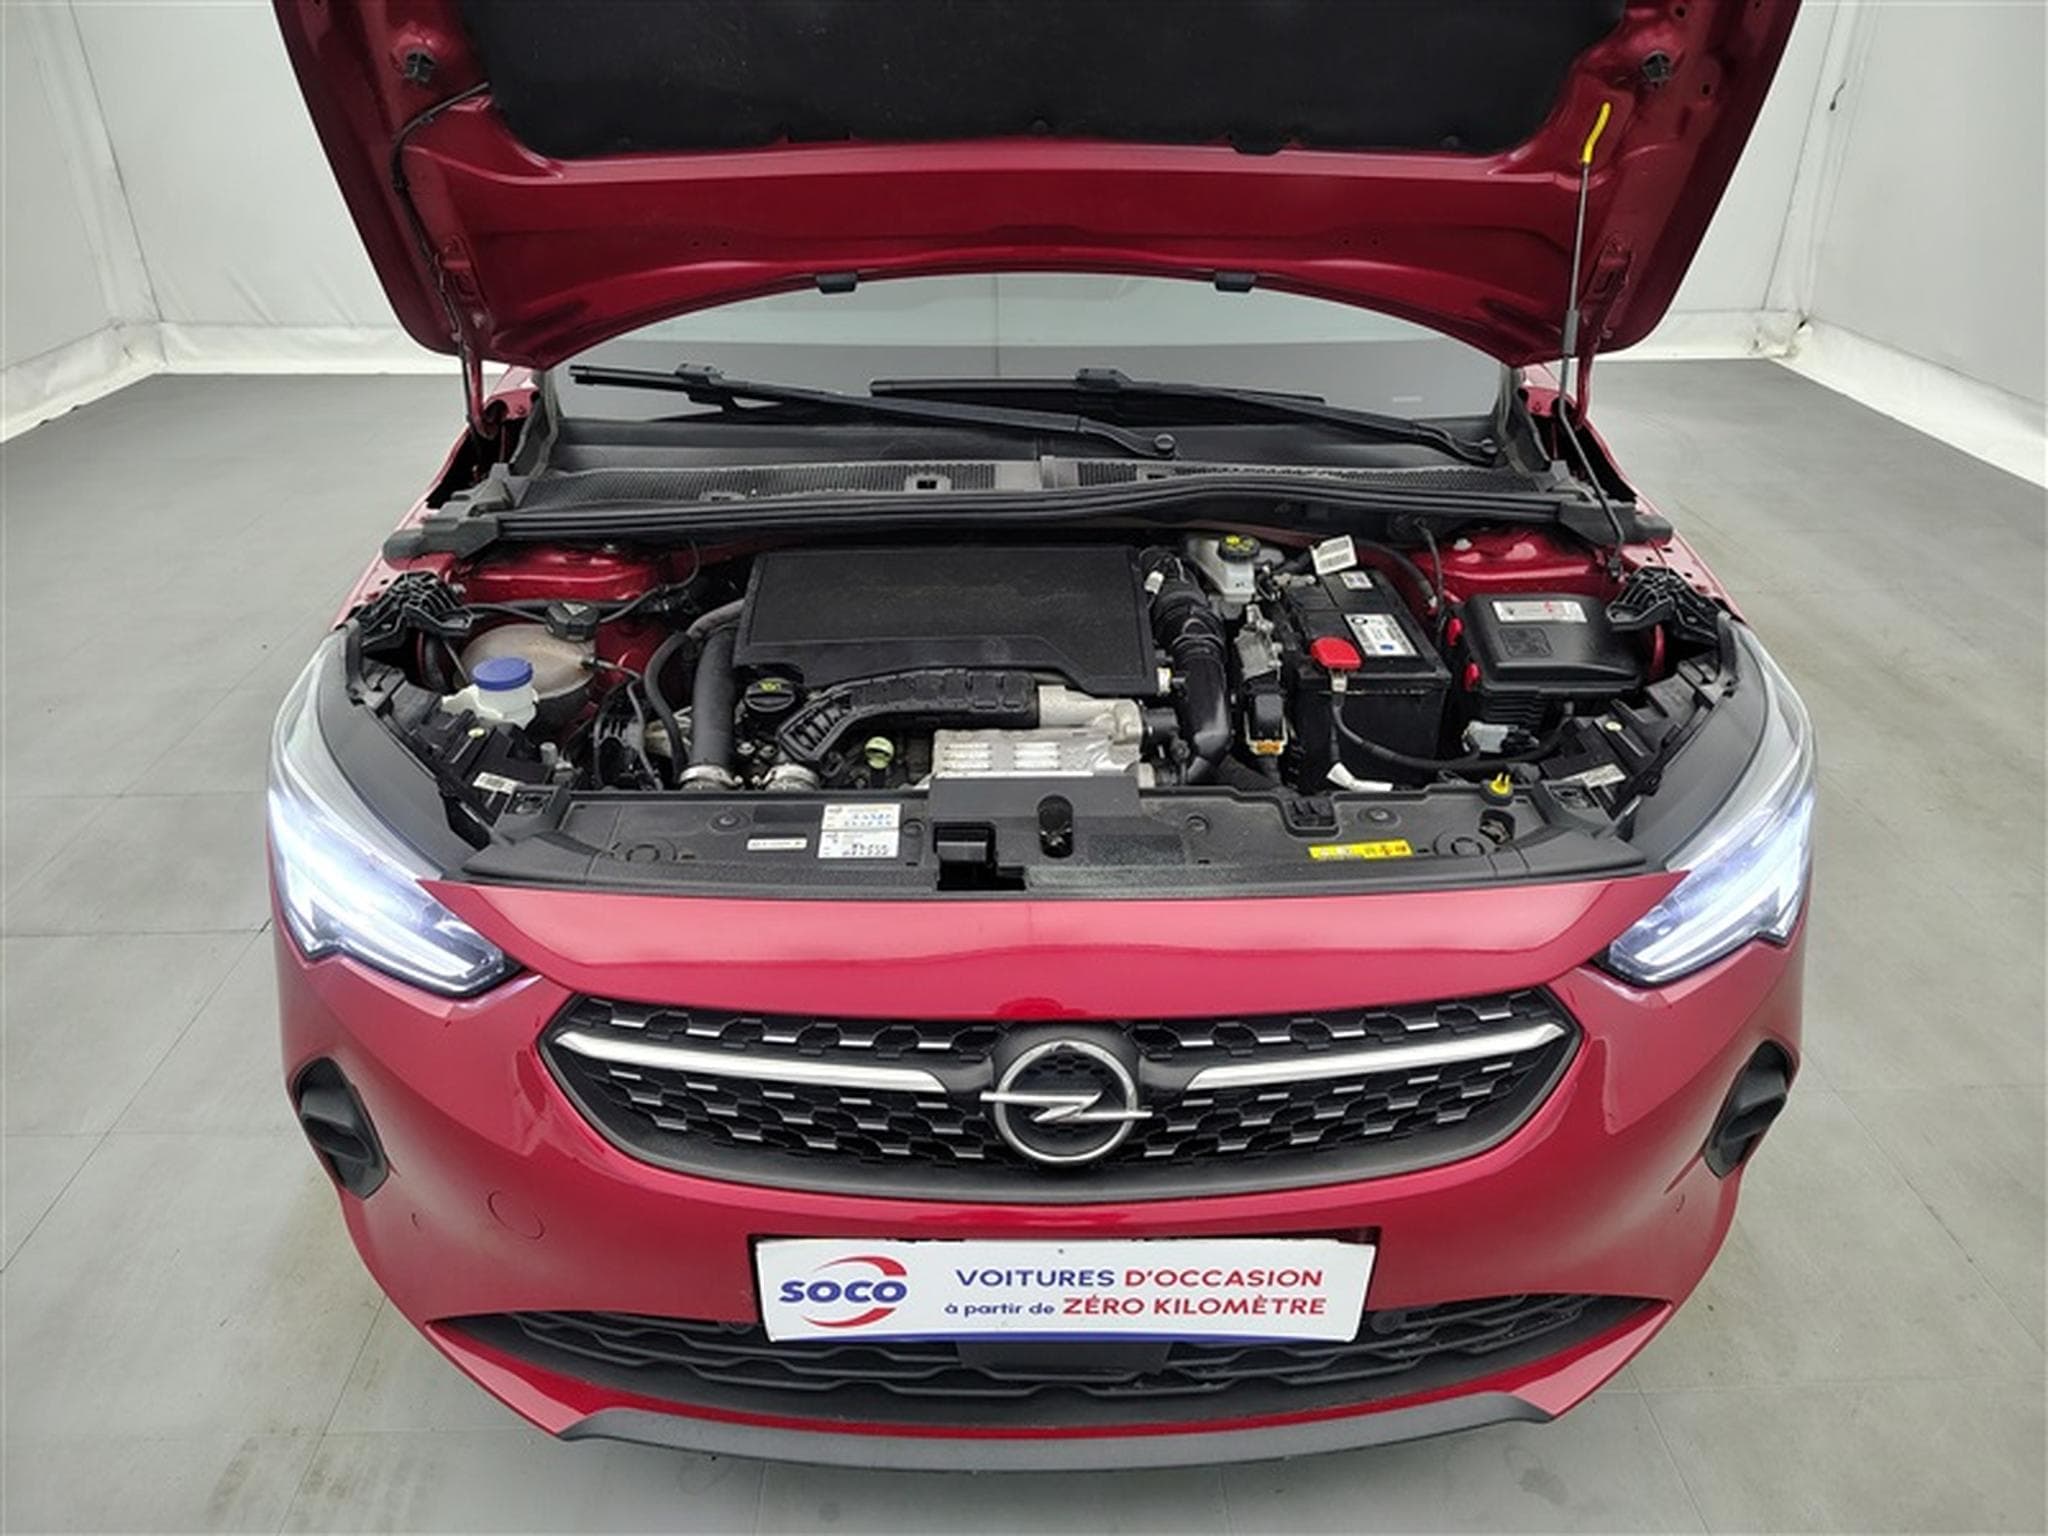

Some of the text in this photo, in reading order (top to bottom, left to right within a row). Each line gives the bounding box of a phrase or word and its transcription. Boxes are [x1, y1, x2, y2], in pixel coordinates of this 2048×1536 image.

[955, 1268, 1324, 1288] VOITURES D'OCCASION
[779, 1279, 908, 1304] SOCO
[945, 1294, 1327, 1318] à partir de ZÉRO KILOMÈTRE
